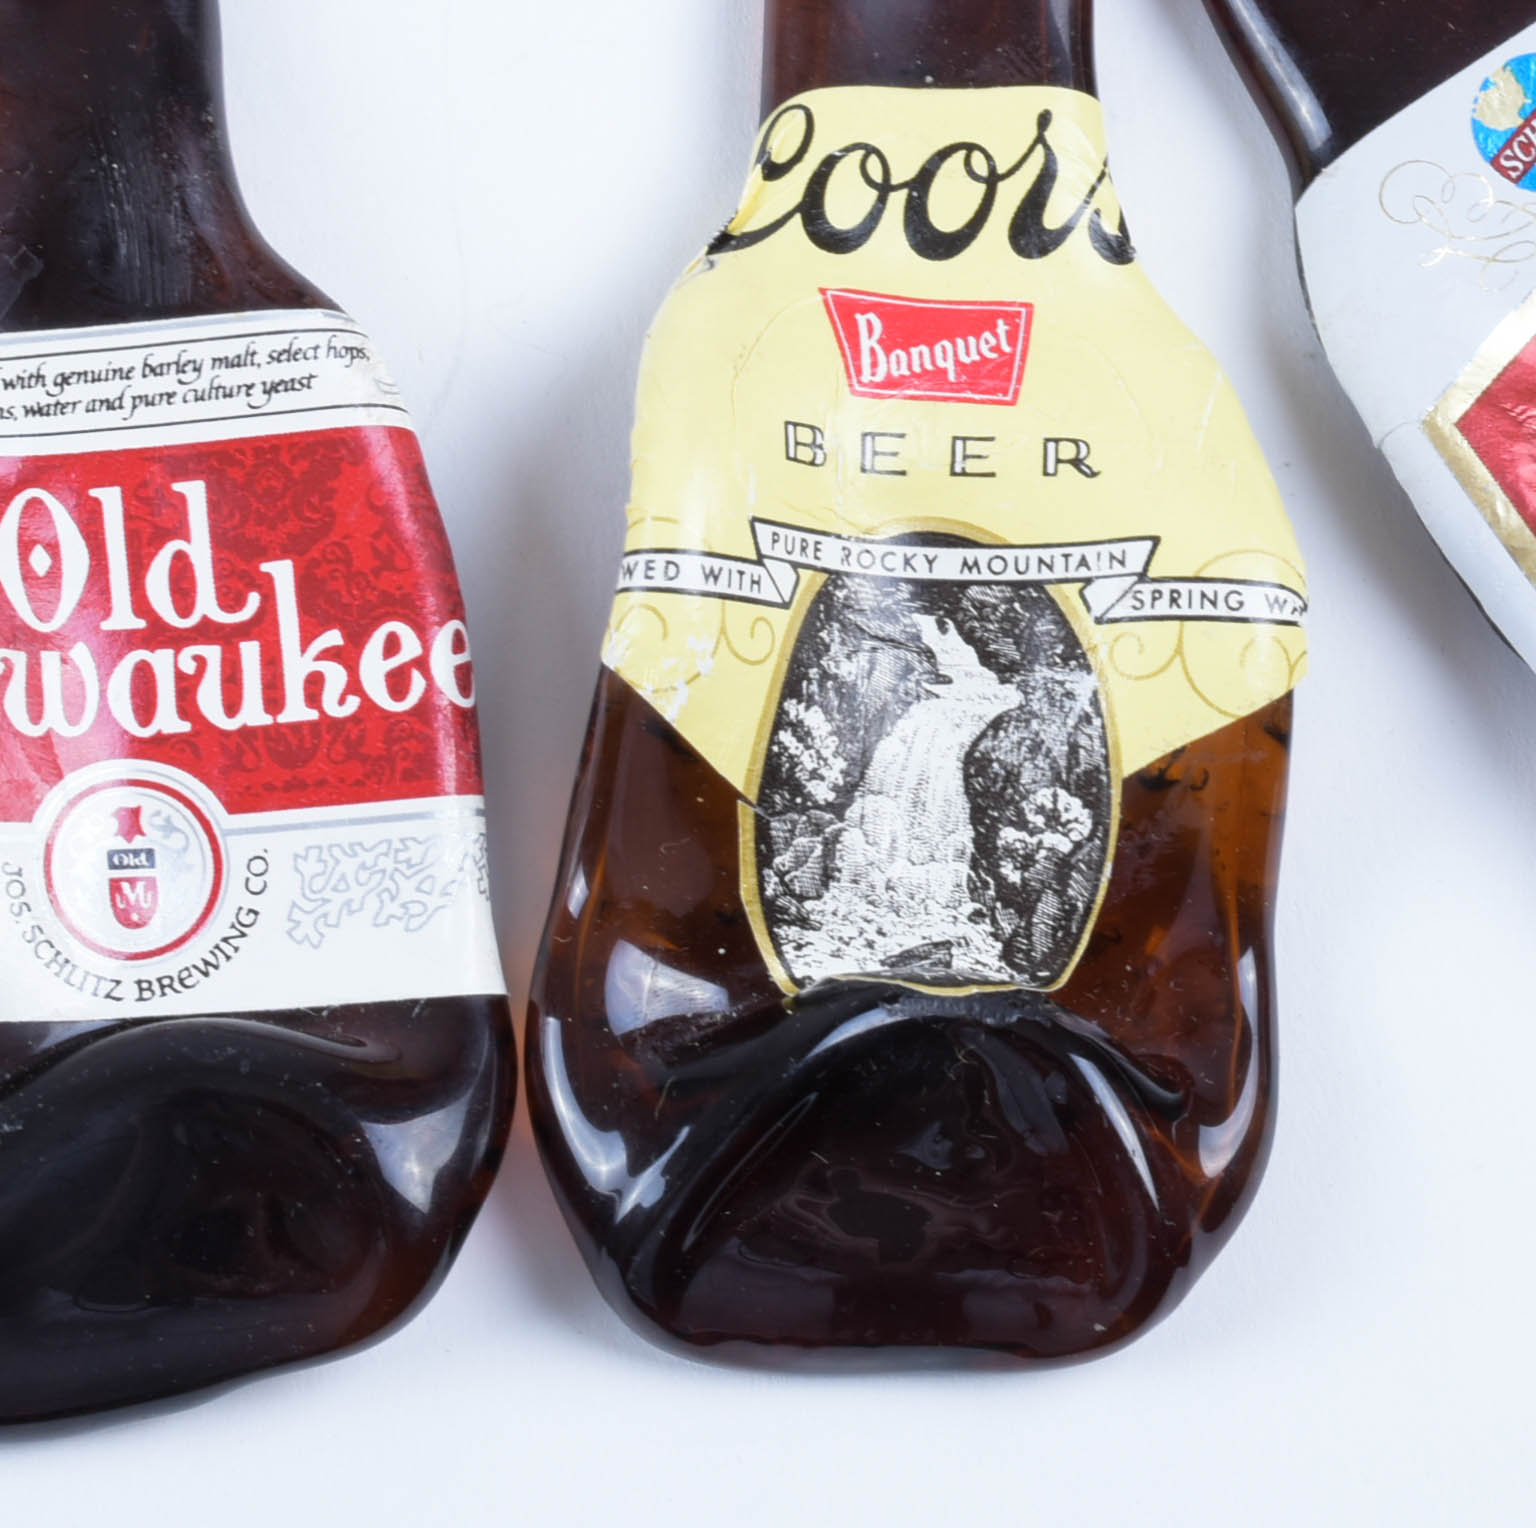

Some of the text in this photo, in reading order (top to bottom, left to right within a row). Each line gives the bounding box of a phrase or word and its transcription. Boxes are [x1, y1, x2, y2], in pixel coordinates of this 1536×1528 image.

[706, 102, 1137, 266] Coors
[1, 362, 47, 392] with
[45, 360, 135, 397] genuine
[142, 349, 205, 385] barley
[211, 341, 261, 368] malt,
[266, 336, 320, 365] select
[326, 334, 370, 368] hops,
[856, 312, 1015, 384] Banquet
[22, 398, 82, 418] water
[85, 385, 132, 414] and
[122, 389, 177, 421] pure
[182, 374, 254, 404] culture
[247, 373, 318, 410] yeast
[784, 421, 1102, 480] BEER
[700, 564, 762, 594] WITH
[771, 531, 823, 561] PURE
[839, 545, 939, 574] ROCKY
[959, 548, 1127, 576] MOUNTAIN
[1131, 588, 1246, 612] SPRING
[112, 851, 149, 868] Old
[1, 848, 270, 1002] JOS. SCHLITZ BREWING CO.
